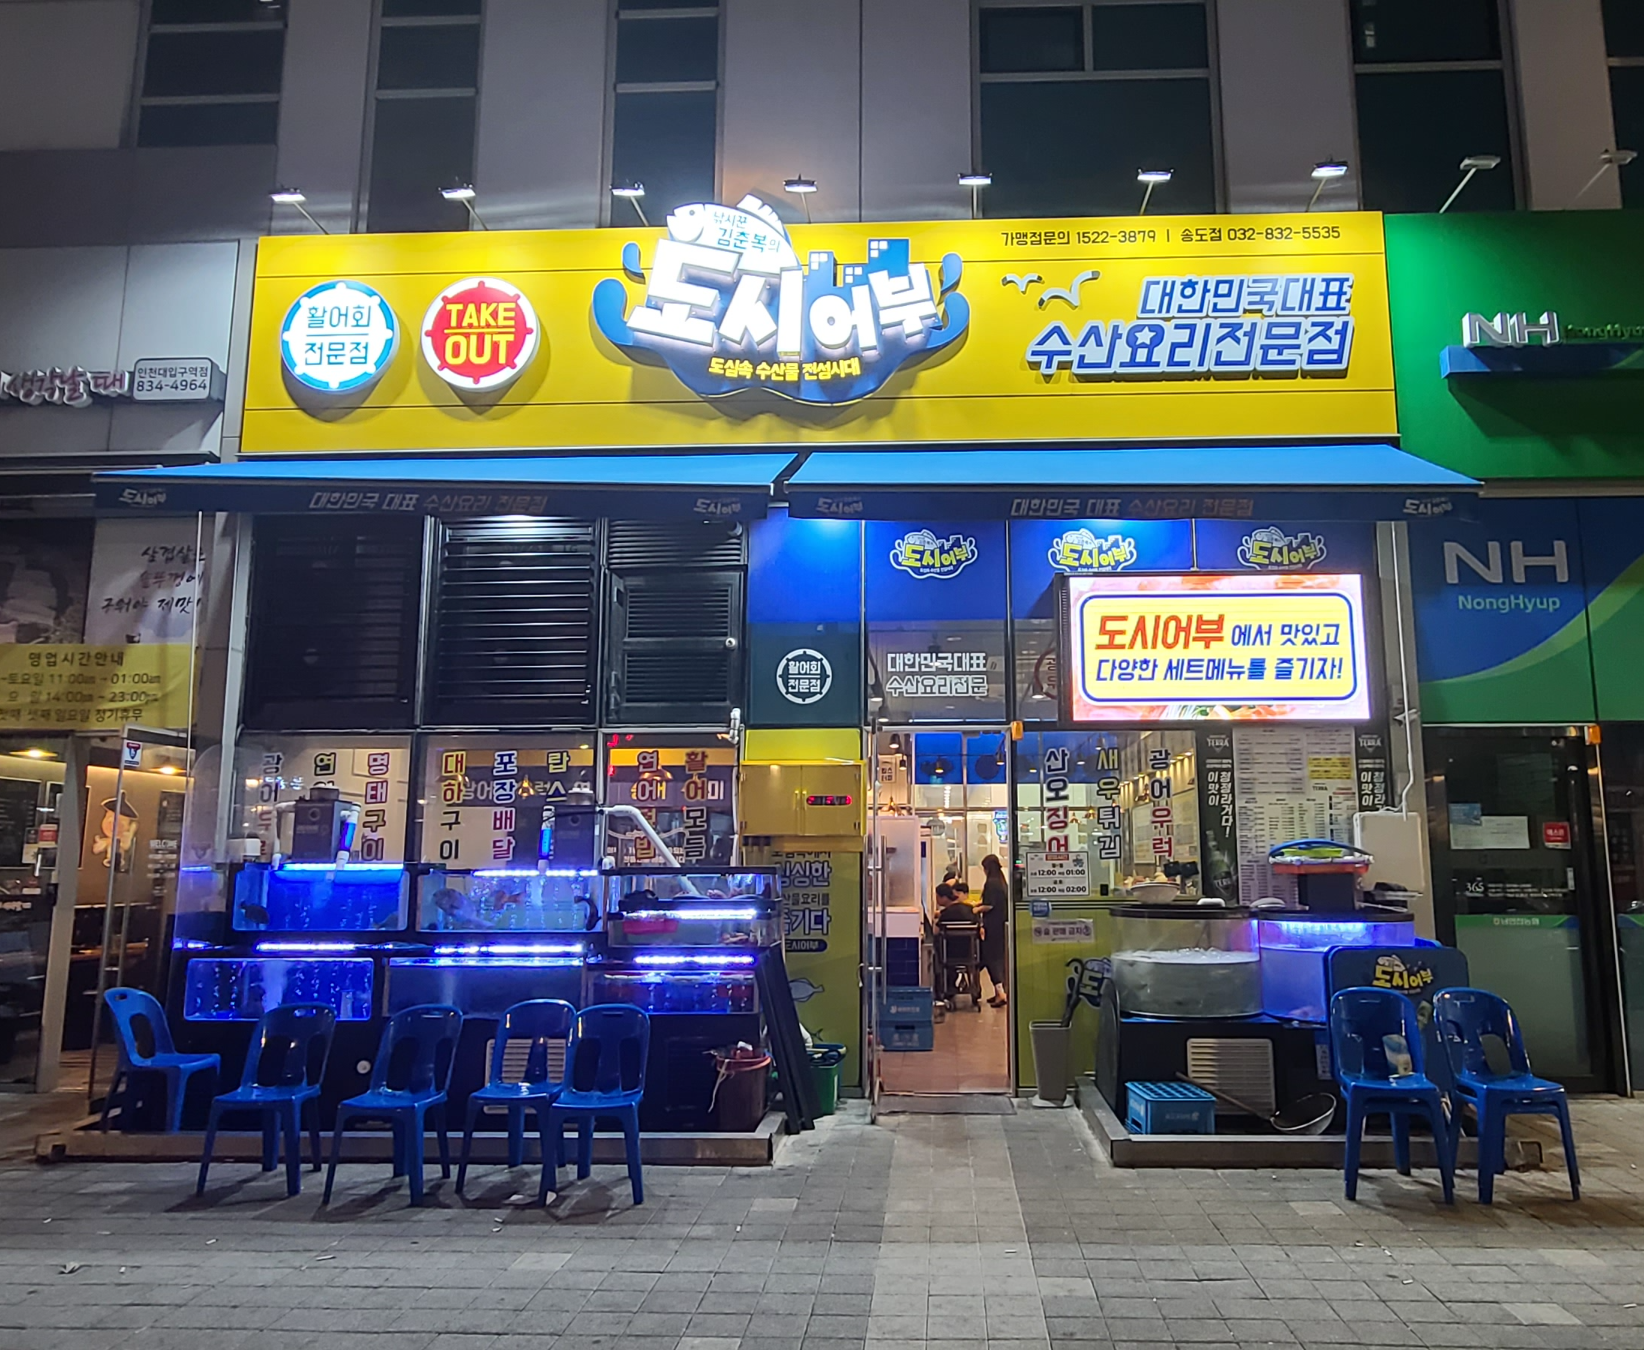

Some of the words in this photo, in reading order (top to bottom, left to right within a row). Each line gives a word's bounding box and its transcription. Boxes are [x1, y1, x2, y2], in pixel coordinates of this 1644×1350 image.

[714, 211, 747, 229] 낚시꾼
[717, 227, 781, 253] 김춘복의
[1000, 230, 1071, 246] 가맹점문의
[1075, 230, 1156, 244] 1522-3879
[1180, 227, 1223, 242] 송도점
[1227, 226, 1341, 241] 032-832-5535
[626, 238, 941, 355] 도시어부
[1140, 277, 1351, 314] 대한민국대표
[307, 305, 371, 328] 활어회
[445, 302, 516, 327] TAKE
[1462, 311, 1560, 348] NH
[304, 342, 369, 365] 전문점
[445, 334, 515, 364] OUT
[1030, 320, 1350, 369] 수산요리전문점
[138, 366, 209, 378] 인천대입구역점
[708, 357, 753, 379] 도심속
[755, 361, 799, 381] 수산물
[802, 357, 861, 381] 전성시대
[136, 379, 207, 391] 834-4964
[309, 492, 380, 509] 대한민국
[382, 493, 419, 511] 대표
[423, 494, 492, 512] 수산요리
[1010, 498, 1081, 516] 대한민국
[1086, 499, 1122, 516] 대표
[1128, 498, 1196, 517] 수산요리
[901, 543, 968, 568] 도시어부
[1059, 542, 1127, 568] 도시어부
[1249, 540, 1317, 565] 도시어부
[1443, 540, 1569, 584] NH
[1458, 594, 1560, 613] NongHyup
[1095, 614, 1225, 650] 도시어부
[1231, 624, 1273, 646] 에서
[1280, 623, 1340, 646] 맛있고
[788, 661, 821, 674] 활어회
[887, 652, 987, 672] 대한민국대표
[1096, 658, 1158, 681] 다양한
[1163, 657, 1267, 681] 세트메뉴를
[1274, 657, 1343, 680] 즐기자!
[788, 679, 821, 693] 전문점
[886, 675, 988, 697] 수산요리전문
[362, 752, 391, 862] 명태구이
[439, 751, 467, 861] 대하구이
[492, 751, 518, 861] 포장배달
[683, 750, 708, 861] 활어모듬
[1044, 748, 1070, 852] 산오징어
[1097, 747, 1121, 860] 새우튀김
[1149, 748, 1174, 858] 광어우럭
[1466, 882, 1484, 892] 365
[1372, 965, 1434, 988] 도시어부
